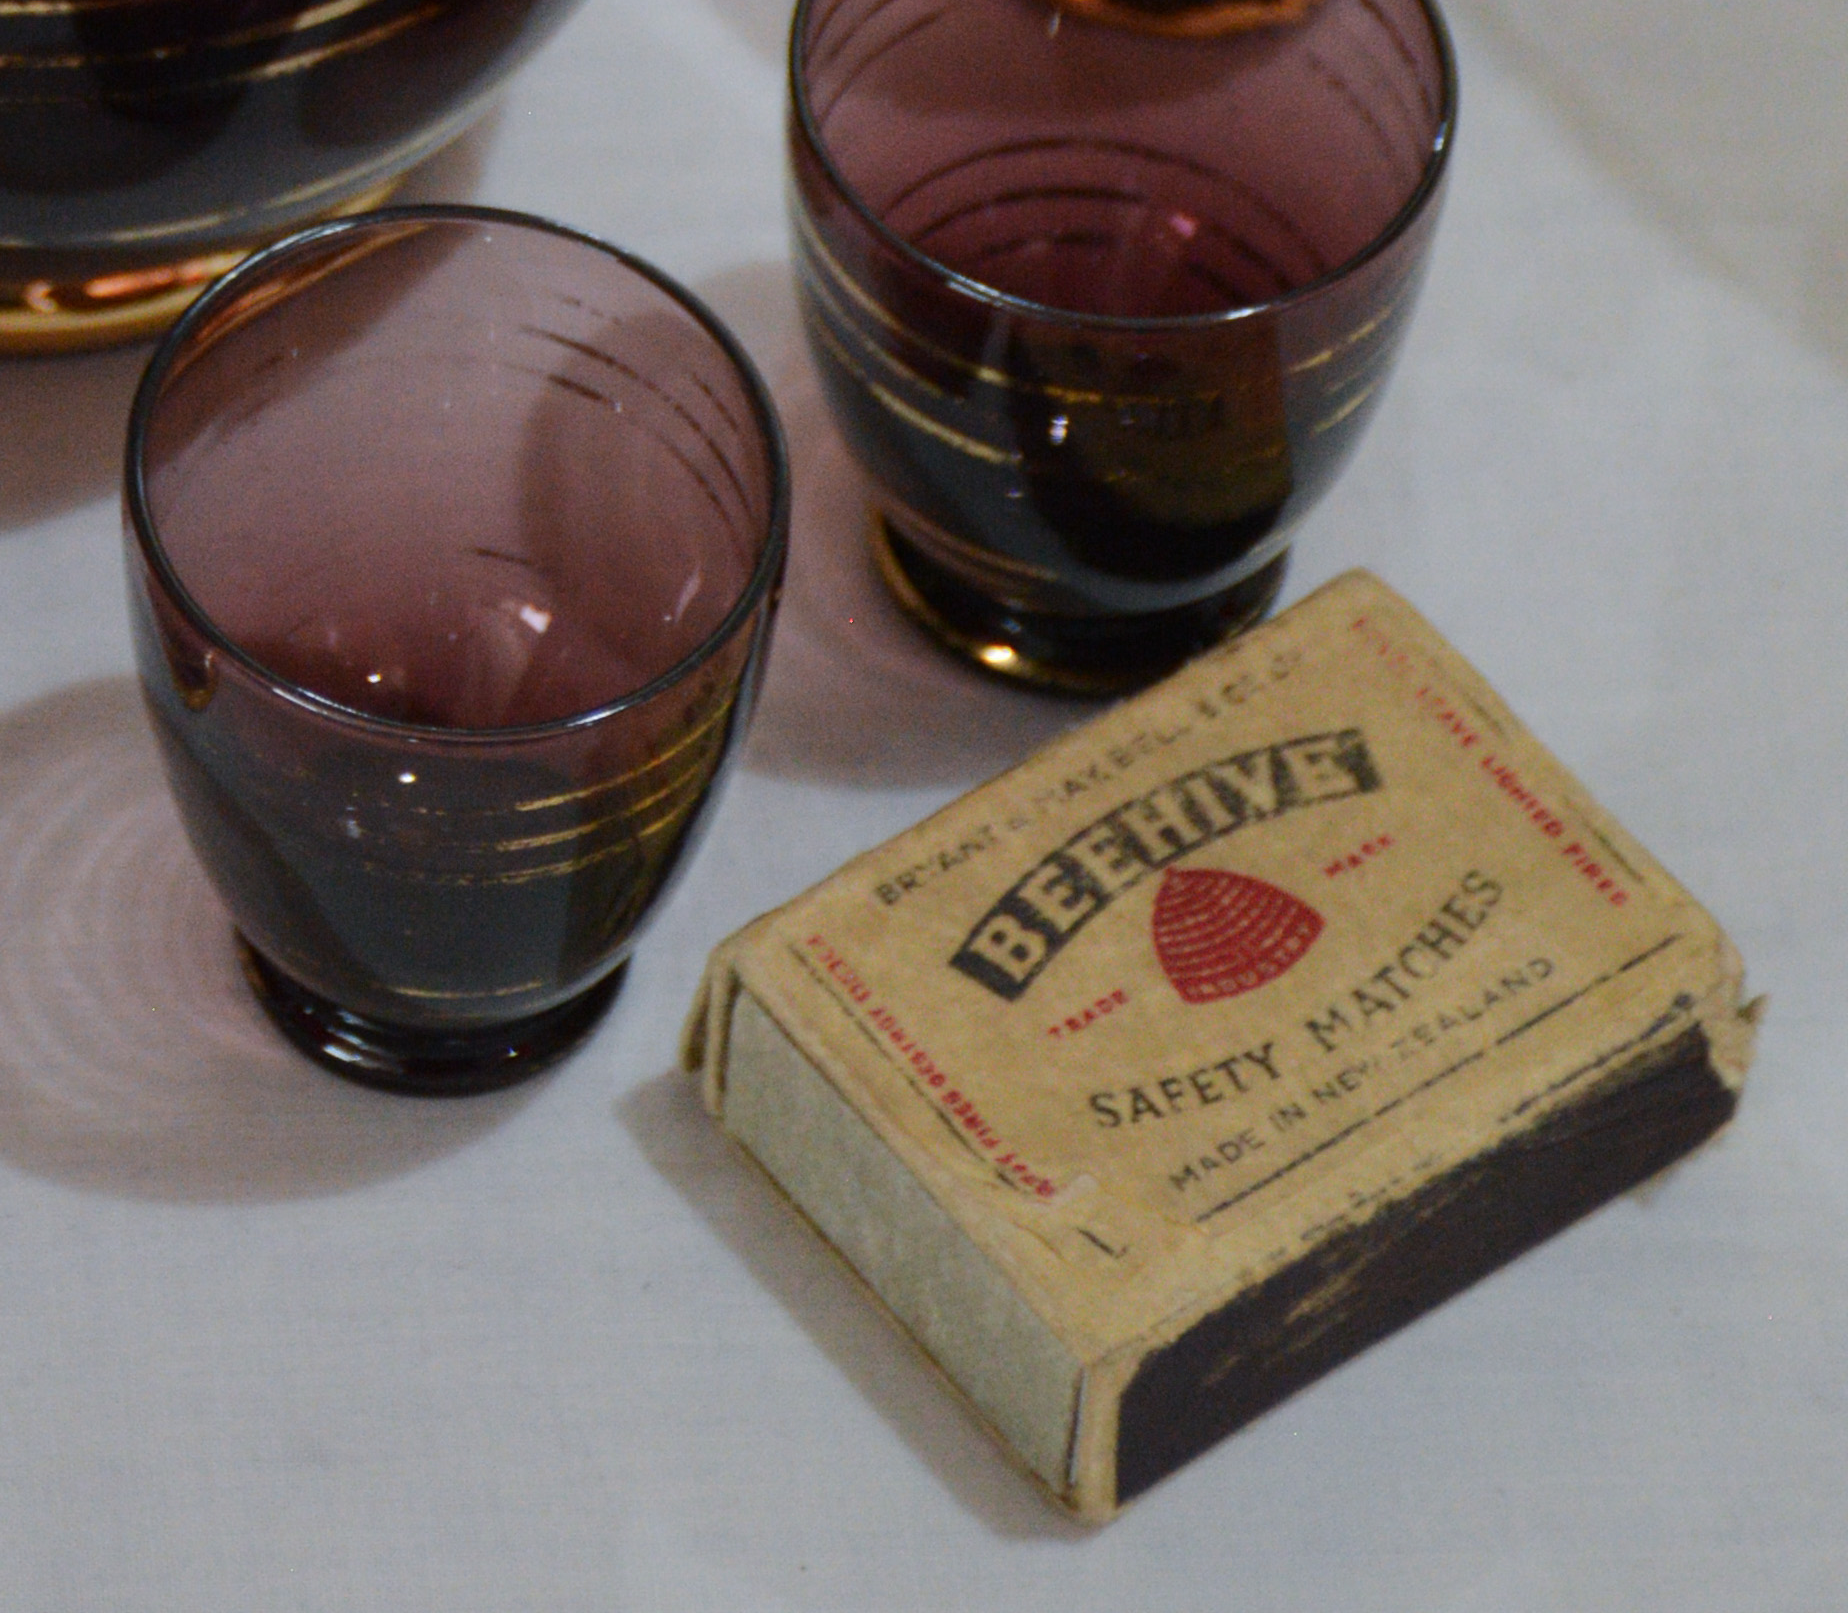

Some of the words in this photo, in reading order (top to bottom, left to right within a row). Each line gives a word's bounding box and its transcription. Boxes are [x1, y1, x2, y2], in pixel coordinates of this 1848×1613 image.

[960, 729, 1374, 993] BEEHIVE
[1048, 987, 1130, 1039] TRADE
[1324, 832, 1393, 877] MARK
[1480, 753, 1564, 839] LIGHTED
[1561, 840, 1629, 907] FIRES
[1088, 1041, 1283, 1129] SAFETY
[1304, 869, 1504, 1053] MATCHES
[1168, 1126, 1266, 1192] MADE
[1268, 1101, 1308, 1134] IN
[1312, 1056, 1384, 1107] NEW
[1388, 955, 1555, 1057] ZEALAND
